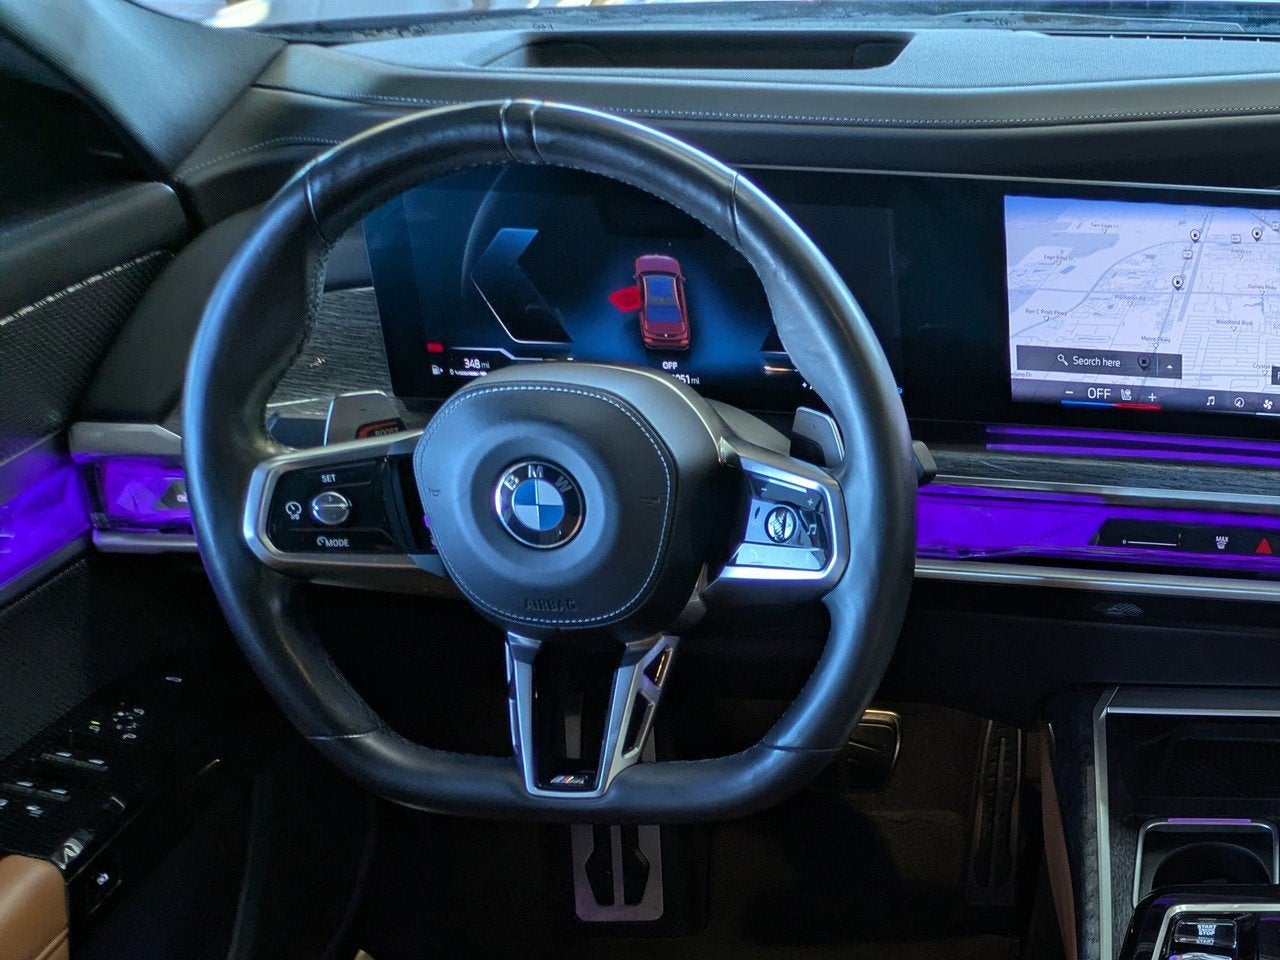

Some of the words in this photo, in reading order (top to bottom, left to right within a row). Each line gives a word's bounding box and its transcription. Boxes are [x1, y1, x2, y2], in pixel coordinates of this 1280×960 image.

[463, 358, 480, 369] 348
[481, 361, 490, 369] mi
[662, 361, 678, 370] OFF
[1073, 356, 1100, 366] Search
[1102, 358, 1121, 368] here
[1087, 387, 1112, 400] OFF
[375, 428, 399, 436] BOOST
[321, 473, 336, 483] SET
[503, 464, 573, 495] BMW
[326, 538, 350, 547] MODE
